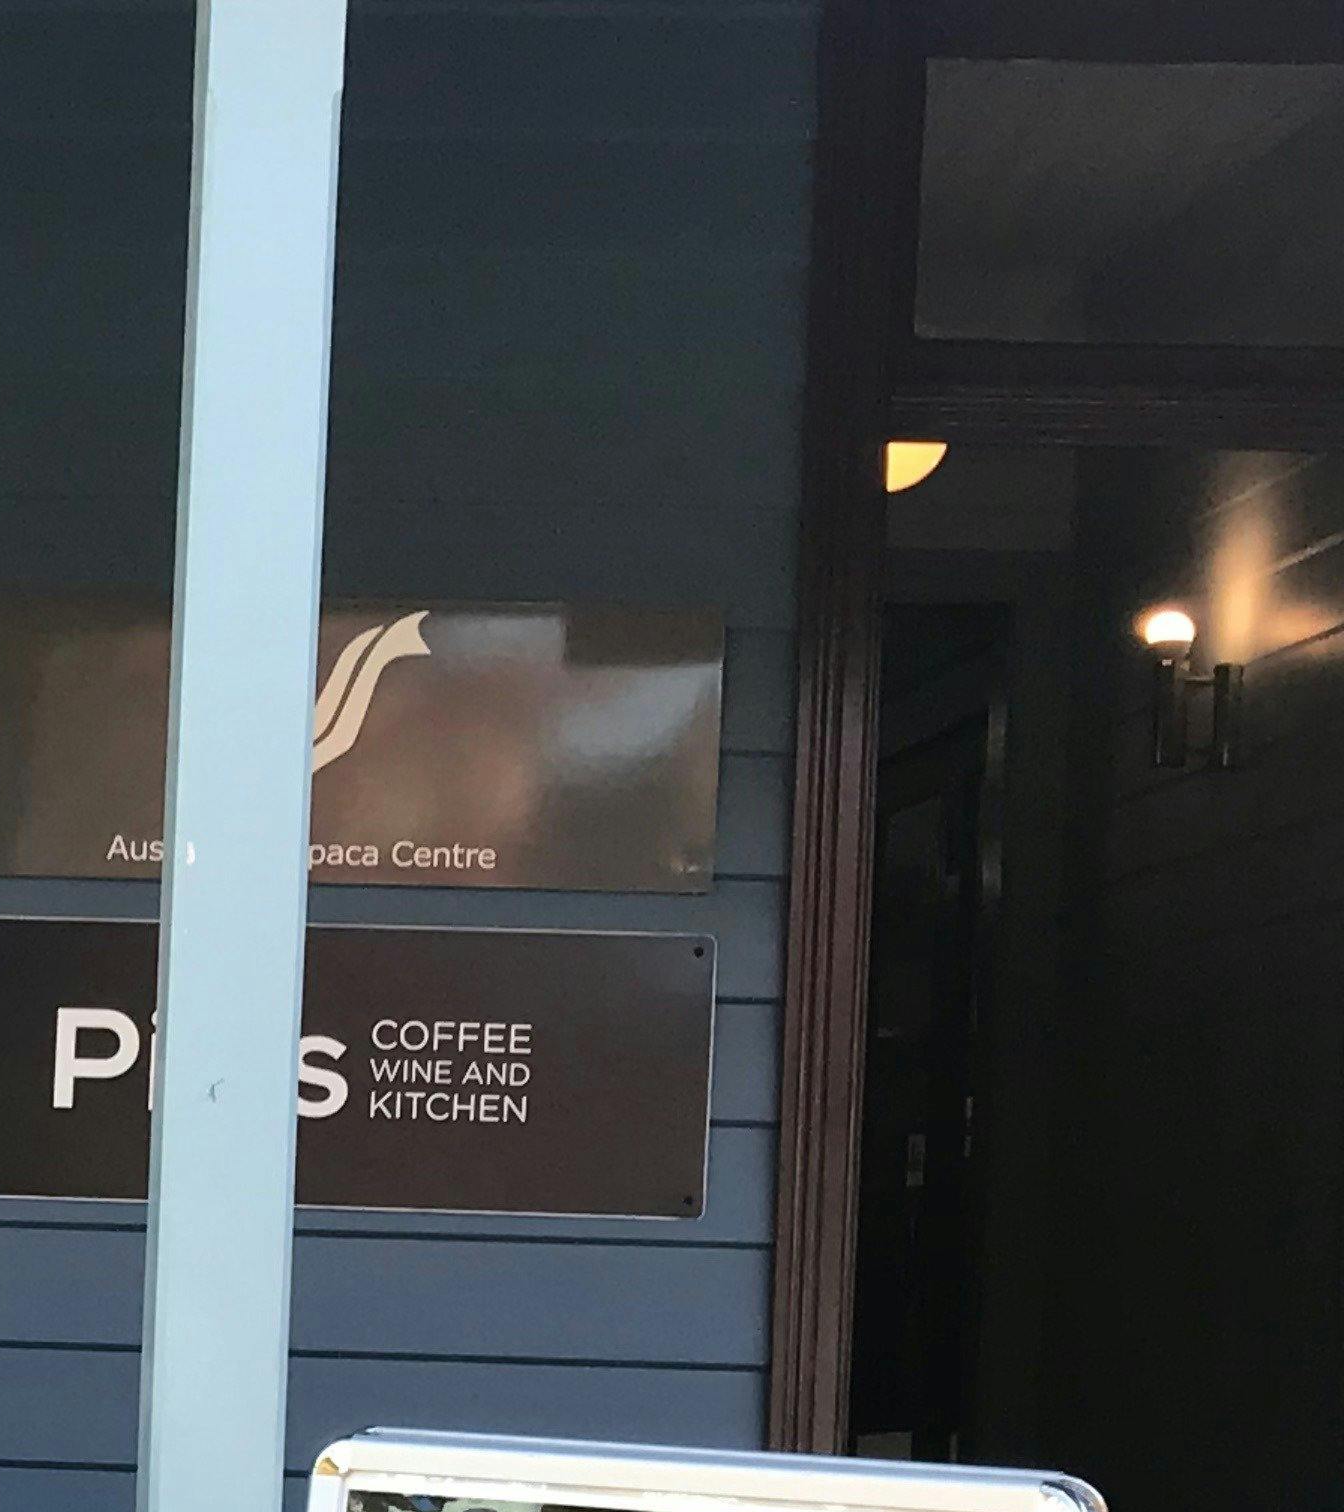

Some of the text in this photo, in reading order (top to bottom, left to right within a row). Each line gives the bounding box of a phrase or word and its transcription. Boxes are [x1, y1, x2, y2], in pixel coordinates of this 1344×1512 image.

[308, 840, 498, 872] paca Centre
[371, 1018, 532, 1055] COFFEE
[369, 1058, 532, 1088] WINE AND
[368, 1091, 528, 1124] KITCHEN
